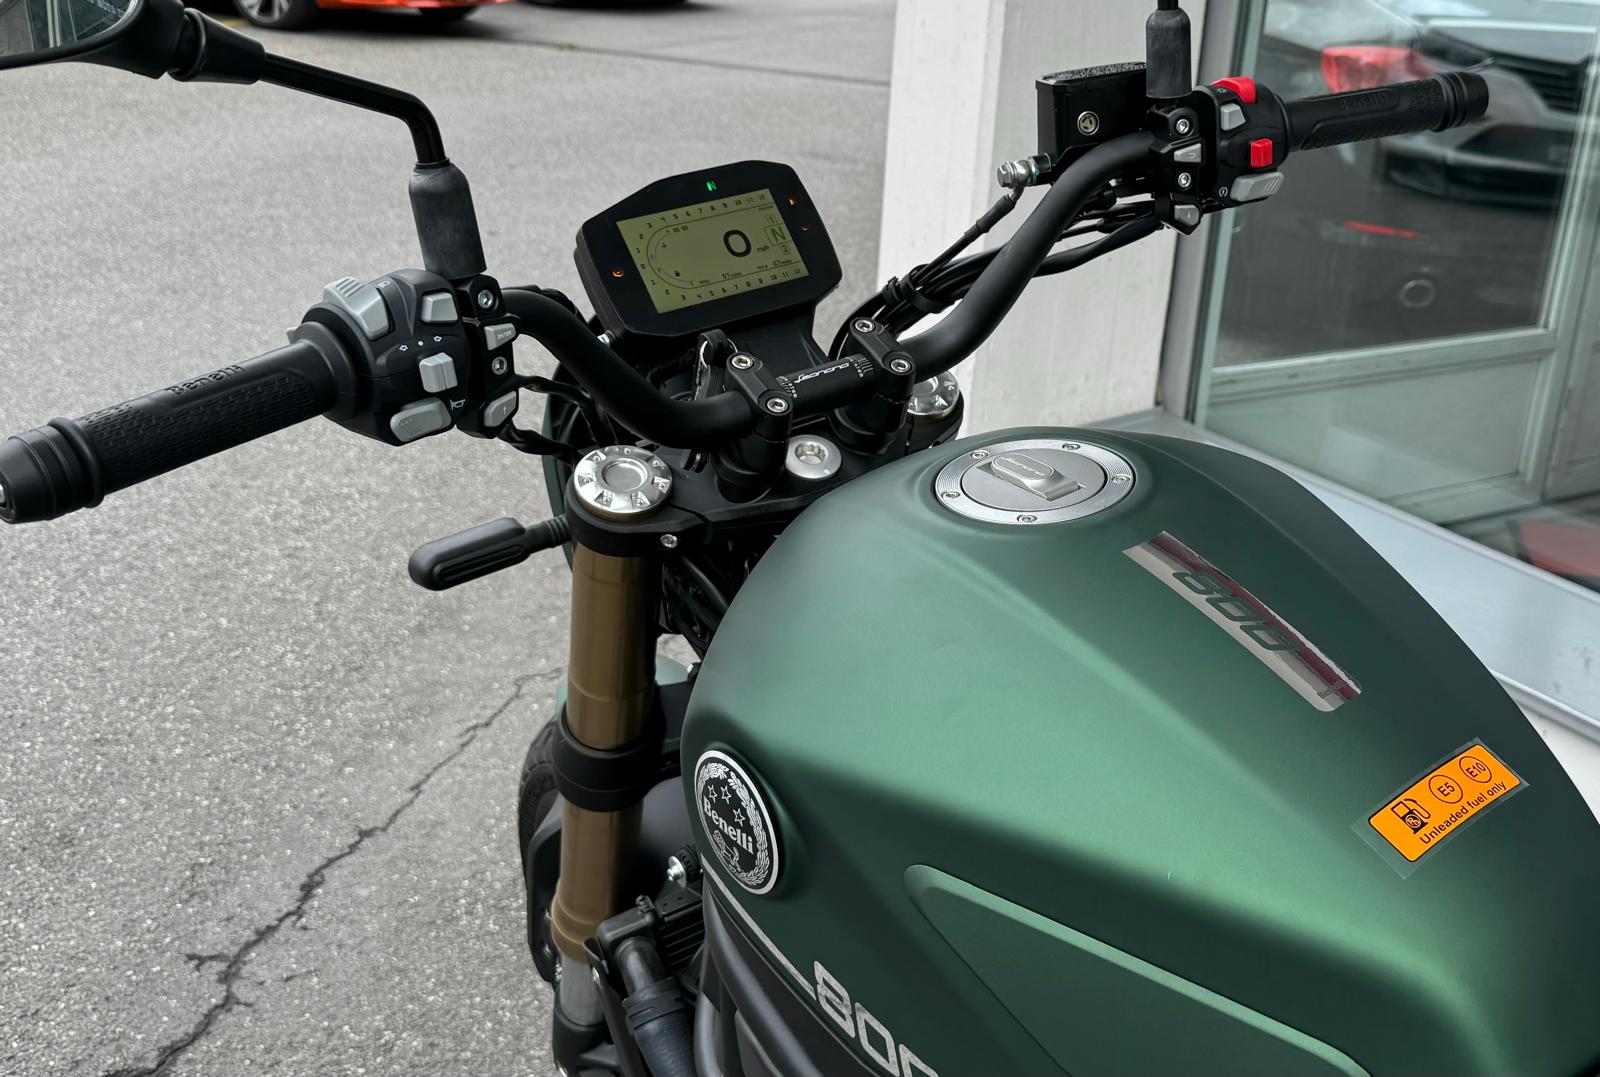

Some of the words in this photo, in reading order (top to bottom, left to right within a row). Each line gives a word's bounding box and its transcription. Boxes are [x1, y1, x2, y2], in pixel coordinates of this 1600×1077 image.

[723, 229, 752, 257] 0
[770, 226, 787, 242] N
[165, 365, 247, 397] Benelli
[1172, 571, 1298, 651] 800
[1437, 782, 1455, 797] E5
[1465, 762, 1486, 778] E10
[703, 796, 753, 854] Benelli
[1419, 805, 1469, 844] Unleaded
[1467, 792, 1487, 809] fuel
[1488, 781, 1507, 797] only
